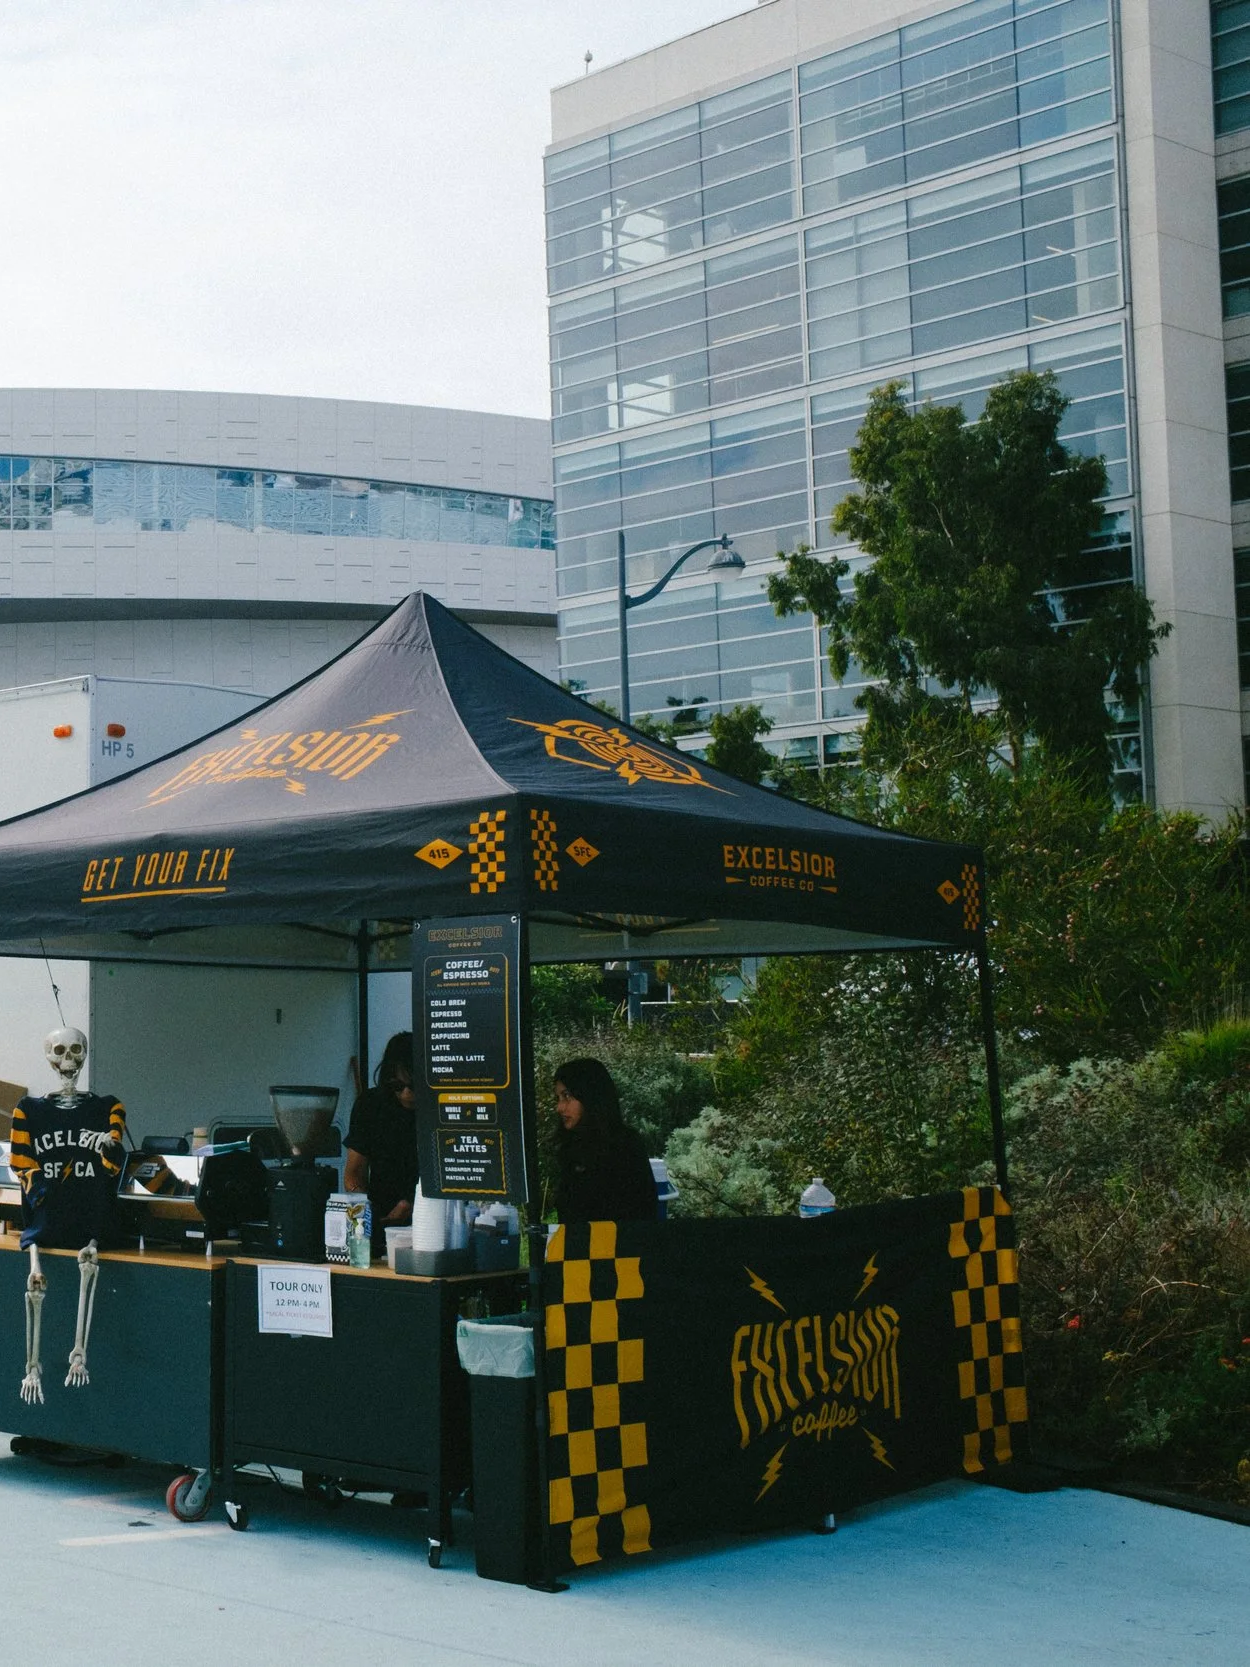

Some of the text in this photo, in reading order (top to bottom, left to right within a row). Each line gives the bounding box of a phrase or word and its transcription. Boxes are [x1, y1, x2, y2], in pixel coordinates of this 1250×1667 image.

[102, 740, 135, 759] HP 5
[428, 848, 450, 859] 415
[573, 846, 592, 858] SFC
[723, 845, 836, 879] EXCELSIOR
[82, 848, 235, 892] GET YOUR FIX
[750, 876, 814, 892] COFFEE CO
[428, 926, 502, 941] EXCELSIOR
[445, 960, 484, 969] COFFEE/
[443, 970, 489, 980] ESPRESSO
[476, 1113, 489, 1121] MILK
[460, 1135, 479, 1144] TEA
[453, 1144, 488, 1153] LATTES
[44, 1161, 96, 1179] SF CA
[269, 1281, 324, 1294] TOUR ONLY
[276, 1299, 286, 1307] 12
[302, 1300, 308, 1308] 4
[309, 1301, 320, 1309] PM
[731, 1304, 900, 1450] EXCELSIOR
[792, 1400, 859, 1442] coffee
